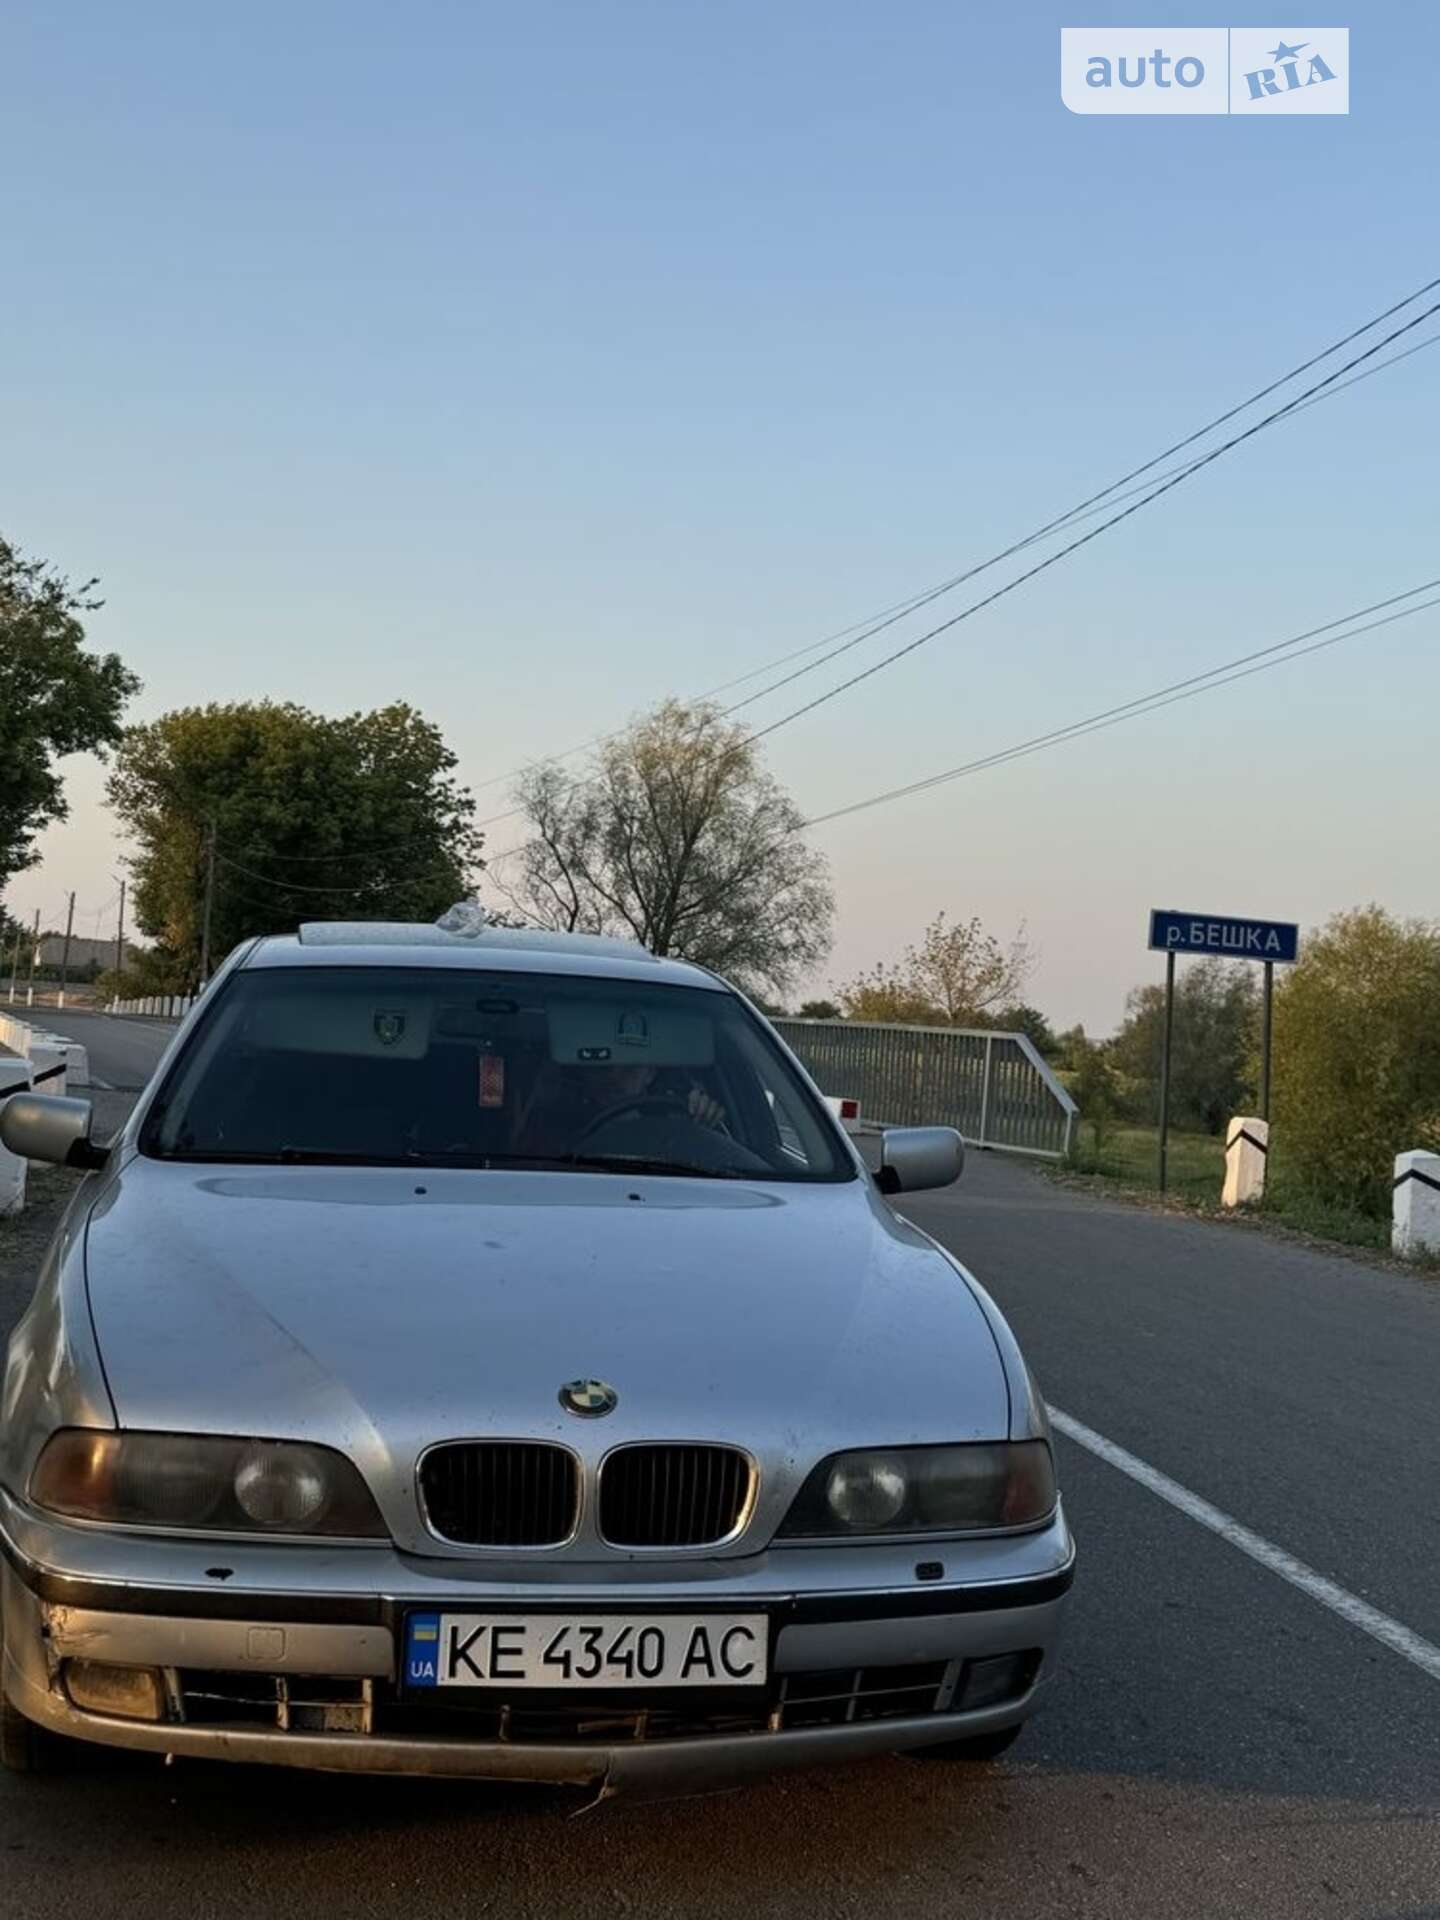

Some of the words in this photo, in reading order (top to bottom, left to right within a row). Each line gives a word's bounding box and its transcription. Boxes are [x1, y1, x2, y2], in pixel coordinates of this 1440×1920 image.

[411, 1661, 434, 1678] UA
[448, 1625, 527, 1679] KE
[543, 1626, 665, 1679] 4340
[681, 1625, 756, 1679] AC
